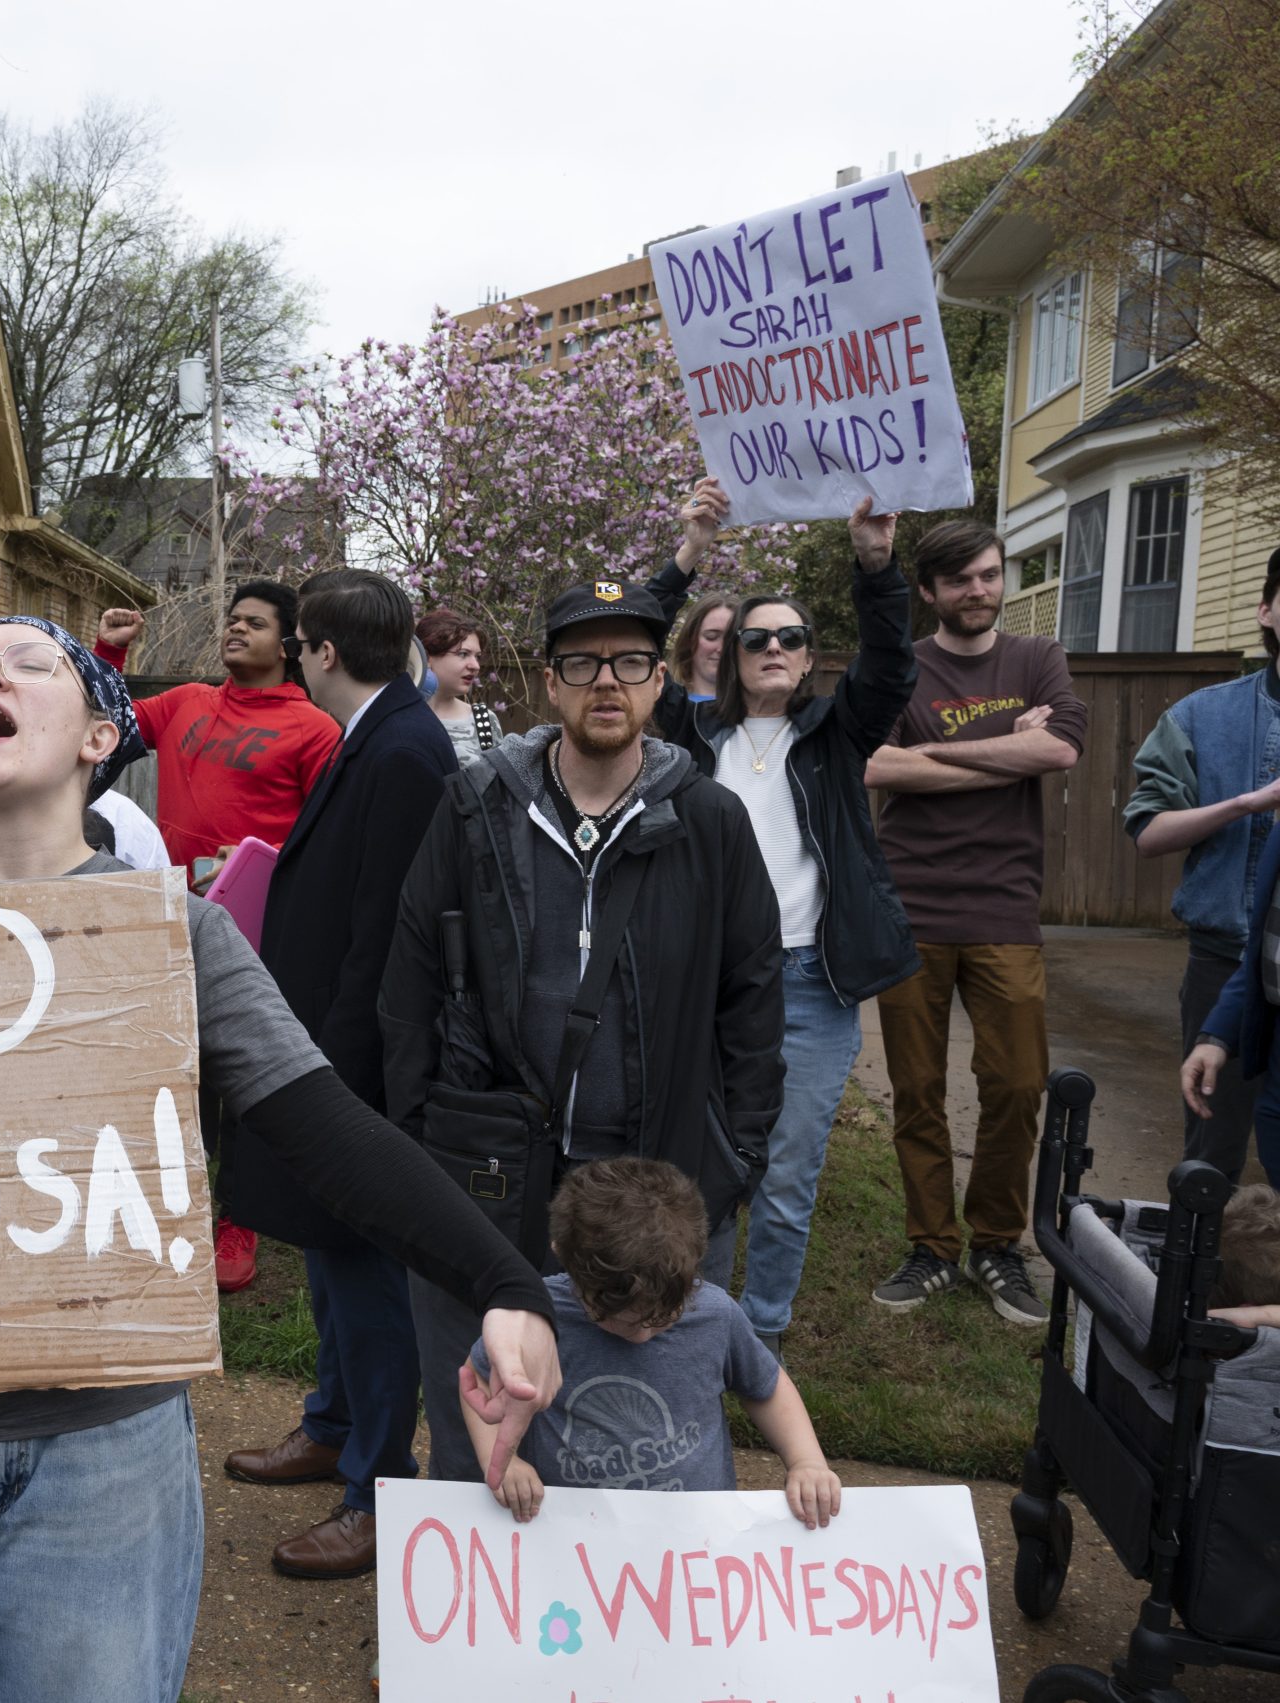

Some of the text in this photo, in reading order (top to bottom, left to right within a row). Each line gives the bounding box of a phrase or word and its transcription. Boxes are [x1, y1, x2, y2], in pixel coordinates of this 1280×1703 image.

[666, 187, 890, 327] DON'T LET
[720, 292, 833, 348] SARAH
[688, 315, 929, 418] INDOCTRINATE
[729, 398, 927, 486] OUR KIDS!
[940, 697, 1025, 736] SUPERMAN
[630, 1421, 701, 1475] Suck
[401, 1517, 983, 1662] ON WEDNESDAYS
